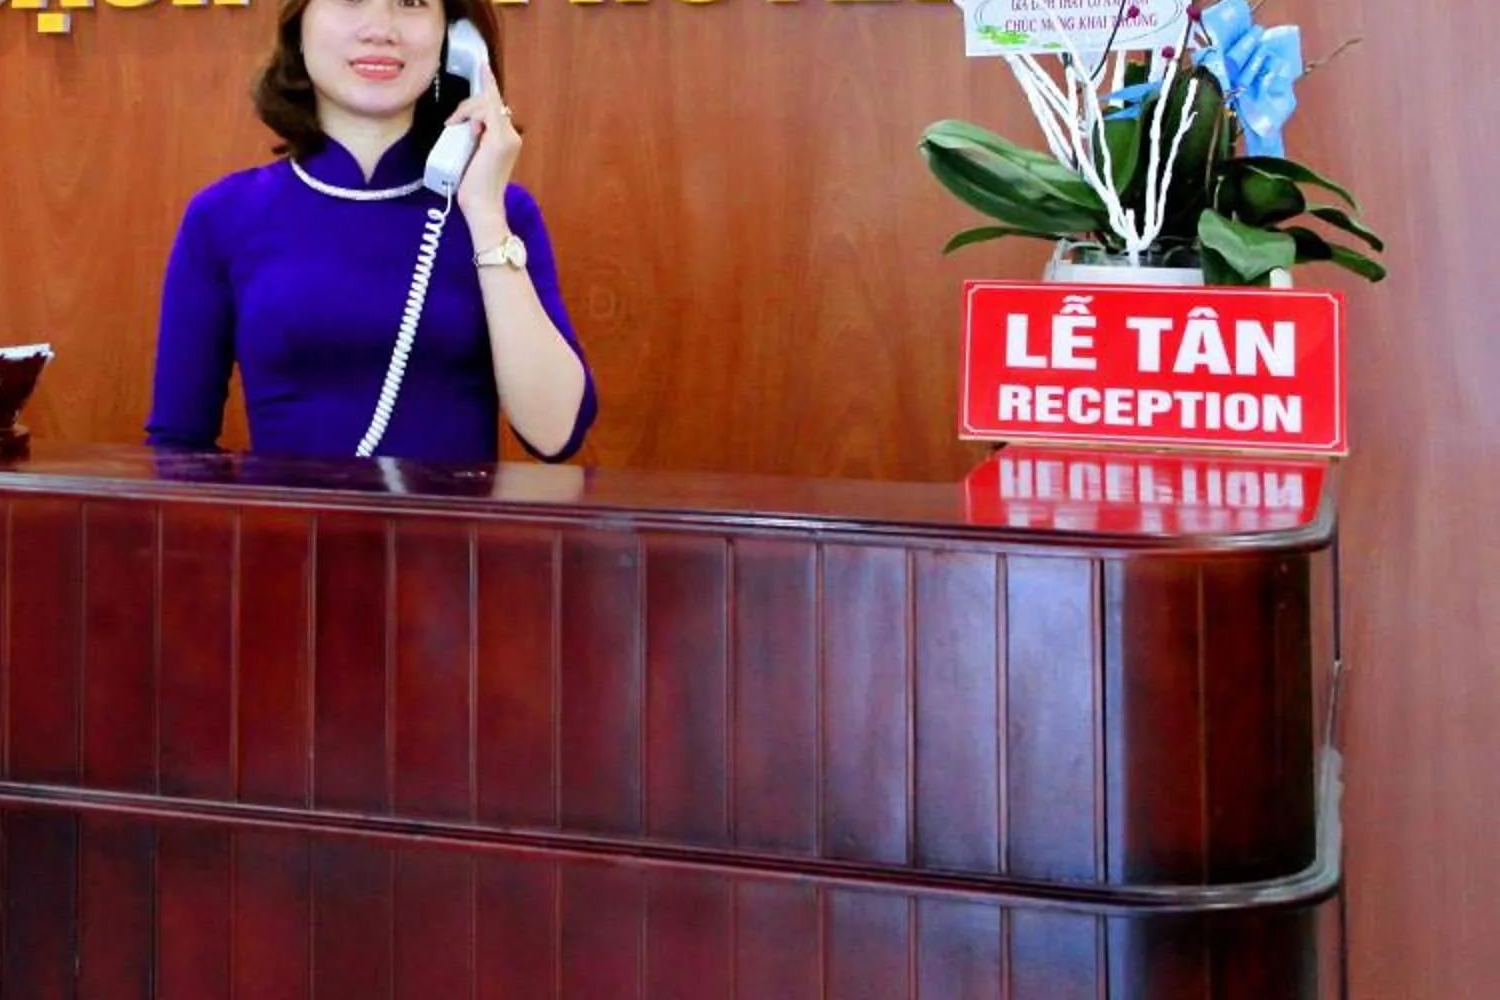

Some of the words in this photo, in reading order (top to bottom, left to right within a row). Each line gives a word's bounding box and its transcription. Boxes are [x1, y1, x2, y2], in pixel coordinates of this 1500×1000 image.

[1005, 295, 1097, 370] LỄ
[1126, 306, 1296, 377] TÂN
[998, 384, 1303, 433] RECEPTION
